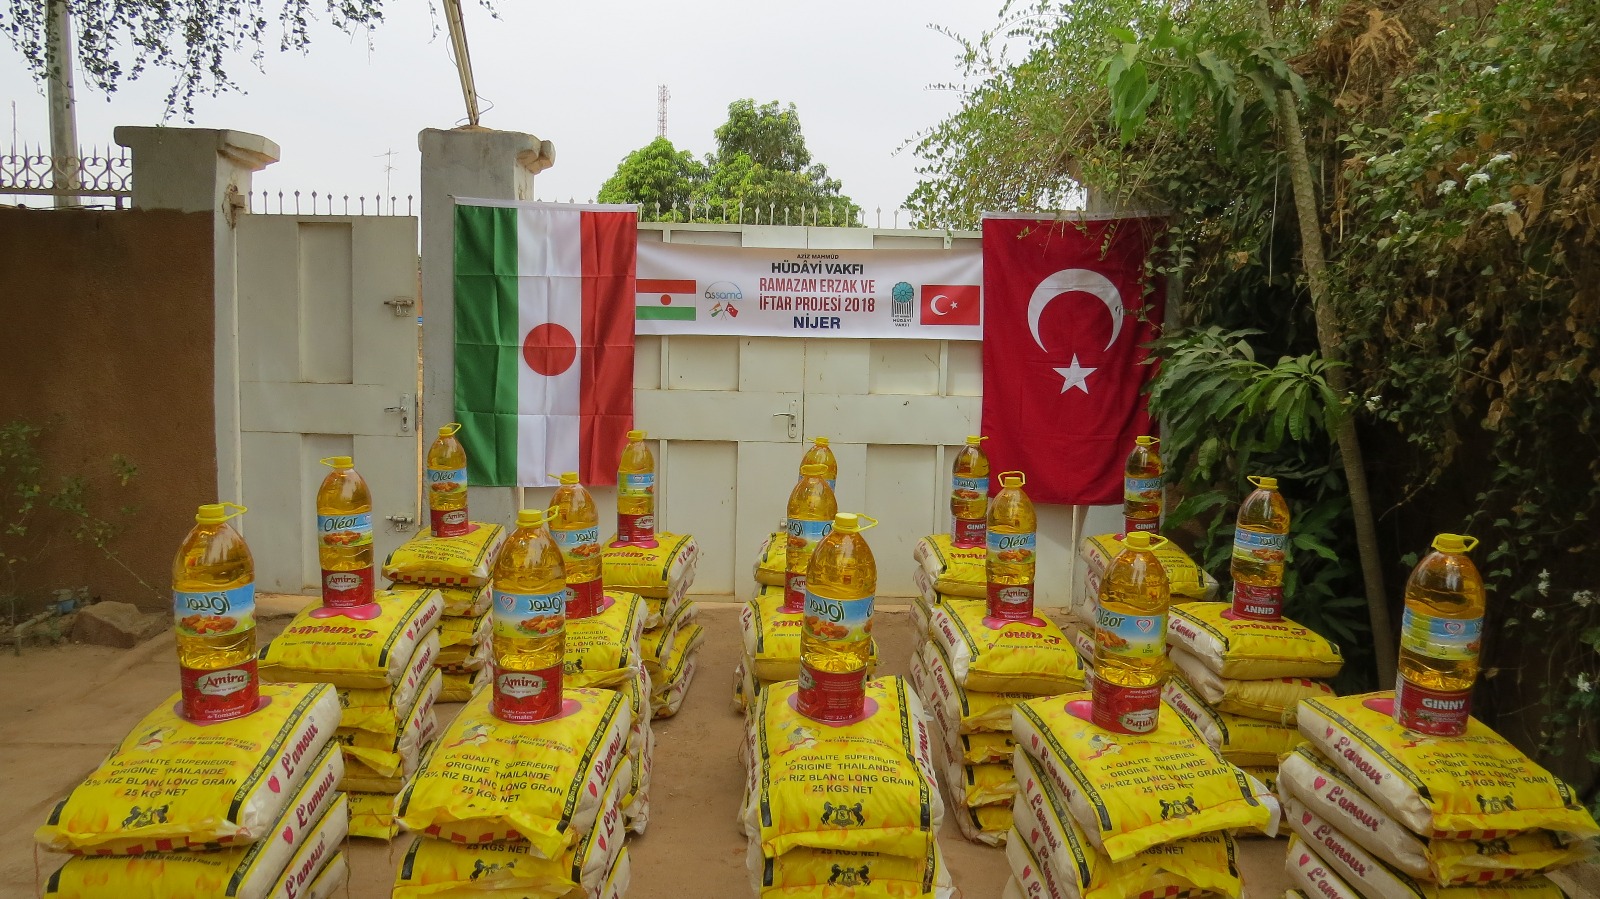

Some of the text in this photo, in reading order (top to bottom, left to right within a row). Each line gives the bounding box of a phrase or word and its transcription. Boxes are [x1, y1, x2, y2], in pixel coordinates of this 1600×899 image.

[772, 260, 864, 275] HÜDÂYİ VAKFI
[704, 288, 742, 300] assama
[760, 278, 876, 294] RAMAZAN ERZAK VE
[760, 293, 876, 312] İFTAR PROJESİ 2018
[794, 313, 841, 329] NİJER
[324, 516, 359, 532] Oléor
[999, 536, 1030, 550] Oléor
[328, 573, 357, 586] Amira
[185, 592, 231, 615] أوليور
[809, 600, 846, 622] أوليور
[1244, 605, 1274, 614] GINNY
[1169, 618, 1197, 642] L'amour
[202, 672, 246, 688] Amira
[502, 676, 540, 688] Amira
[1172, 692, 1199, 722] L'amour
[1422, 698, 1465, 710] GINNY
[214, 710, 242, 718] Tomates
[282, 724, 318, 780] L'amour
[844, 754, 900, 766] SUPERIEURE
[1116, 758, 1151, 768] QUALITE
[1154, 752, 1197, 762] SUPERIEU
[130, 758, 171, 766] QUALITE
[462, 754, 500, 766] QUALITE
[505, 760, 559, 772] SUPERIEURE
[790, 762, 896, 774] ORIGINE THAILANDE
[1110, 758, 1206, 778] ORIGINE THAILANDE
[1334, 736, 1383, 785] L'amour
[110, 767, 158, 776] ORIGINE
[446, 762, 550, 780] ORIGINE THAILANDE
[1041, 746, 1071, 802] L'amour
[1116, 778, 1132, 787] RIZ
[1134, 774, 1166, 784] BLANC
[1169, 772, 1195, 780] LONG
[1197, 766, 1228, 778] GRAIN
[1450, 770, 1486, 778] BLANC
[1488, 770, 1516, 780] LONG
[442, 771, 460, 780] RIZ
[462, 774, 498, 790] BLANC
[500, 782, 527, 792] LONG
[530, 782, 564, 796] GRAIN
[882, 775, 914, 786] GRAIN
[1155, 782, 1176, 791] KGS
[124, 788, 138, 796] 25
[165, 788, 188, 796] NET
[462, 786, 520, 803] 25 KGS NET
[826, 785, 849, 793] KGS
[852, 786, 874, 794] NET
[1082, 780, 1093, 793] Long
[1090, 791, 1102, 806] Grain
[296, 771, 335, 830] L'amour
[564, 782, 578, 817] Riz Blanc
[1326, 784, 1378, 832] L'amour
[1030, 793, 1057, 853] L'amour
[480, 842, 505, 852] KGS
[508, 846, 530, 854] NET
[1074, 846, 1084, 863] Grain
[1164, 846, 1184, 854] NET
[1313, 824, 1366, 877] L'amour
[285, 840, 326, 899] L'amour
[1307, 867, 1344, 899] L'am
